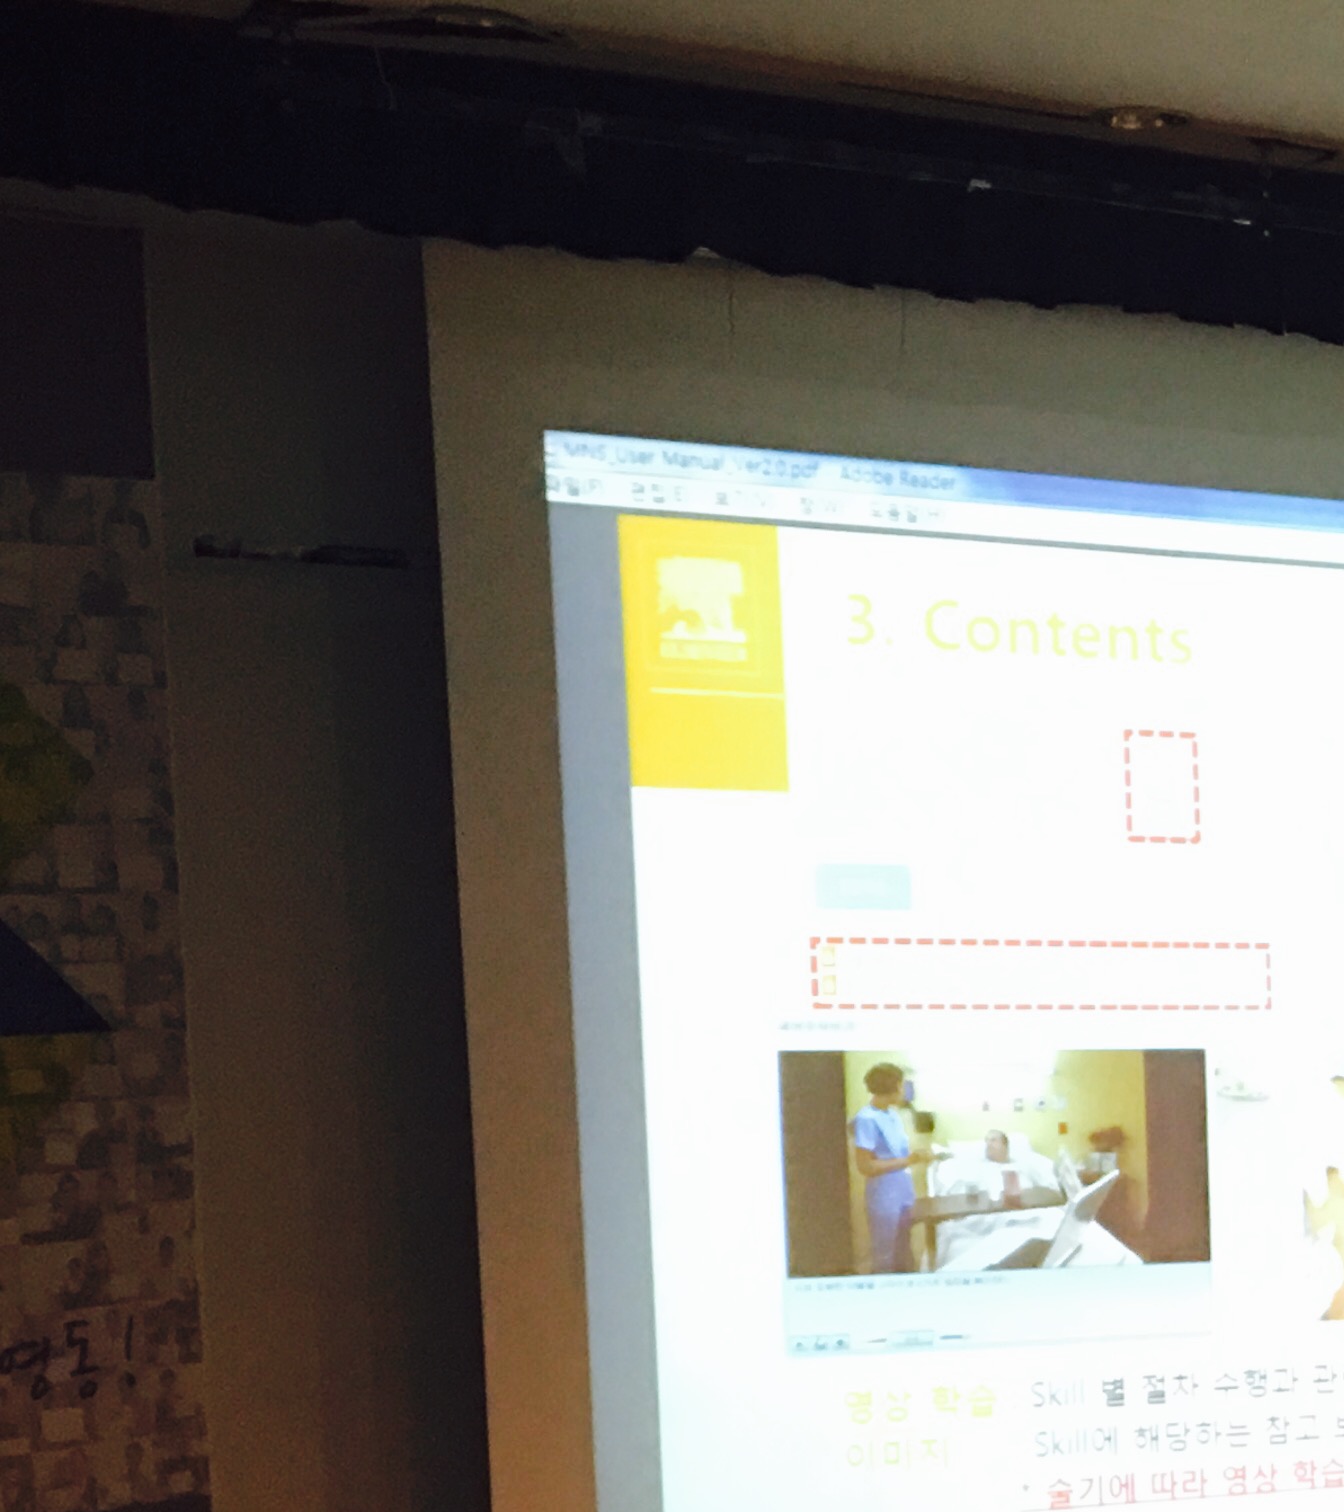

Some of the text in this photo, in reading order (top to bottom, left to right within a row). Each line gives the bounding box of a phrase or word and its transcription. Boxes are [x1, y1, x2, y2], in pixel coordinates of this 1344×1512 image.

[846, 593, 1195, 666] 3. Contents
[843, 1381, 998, 1426] 영상 학습
[1031, 1378, 1086, 1409] Skill
[1141, 1371, 1200, 1406] 절차
[1212, 1366, 1299, 1400] 수행과
[844, 1436, 951, 1470] 이미지
[1033, 1422, 1119, 1458] Skill에
[1134, 1416, 1252, 1452] 해당하는
[1265, 1412, 1321, 1447] 참고
[1149, 1467, 1208, 1500] 따라
[1222, 1461, 1279, 1496] 영상
